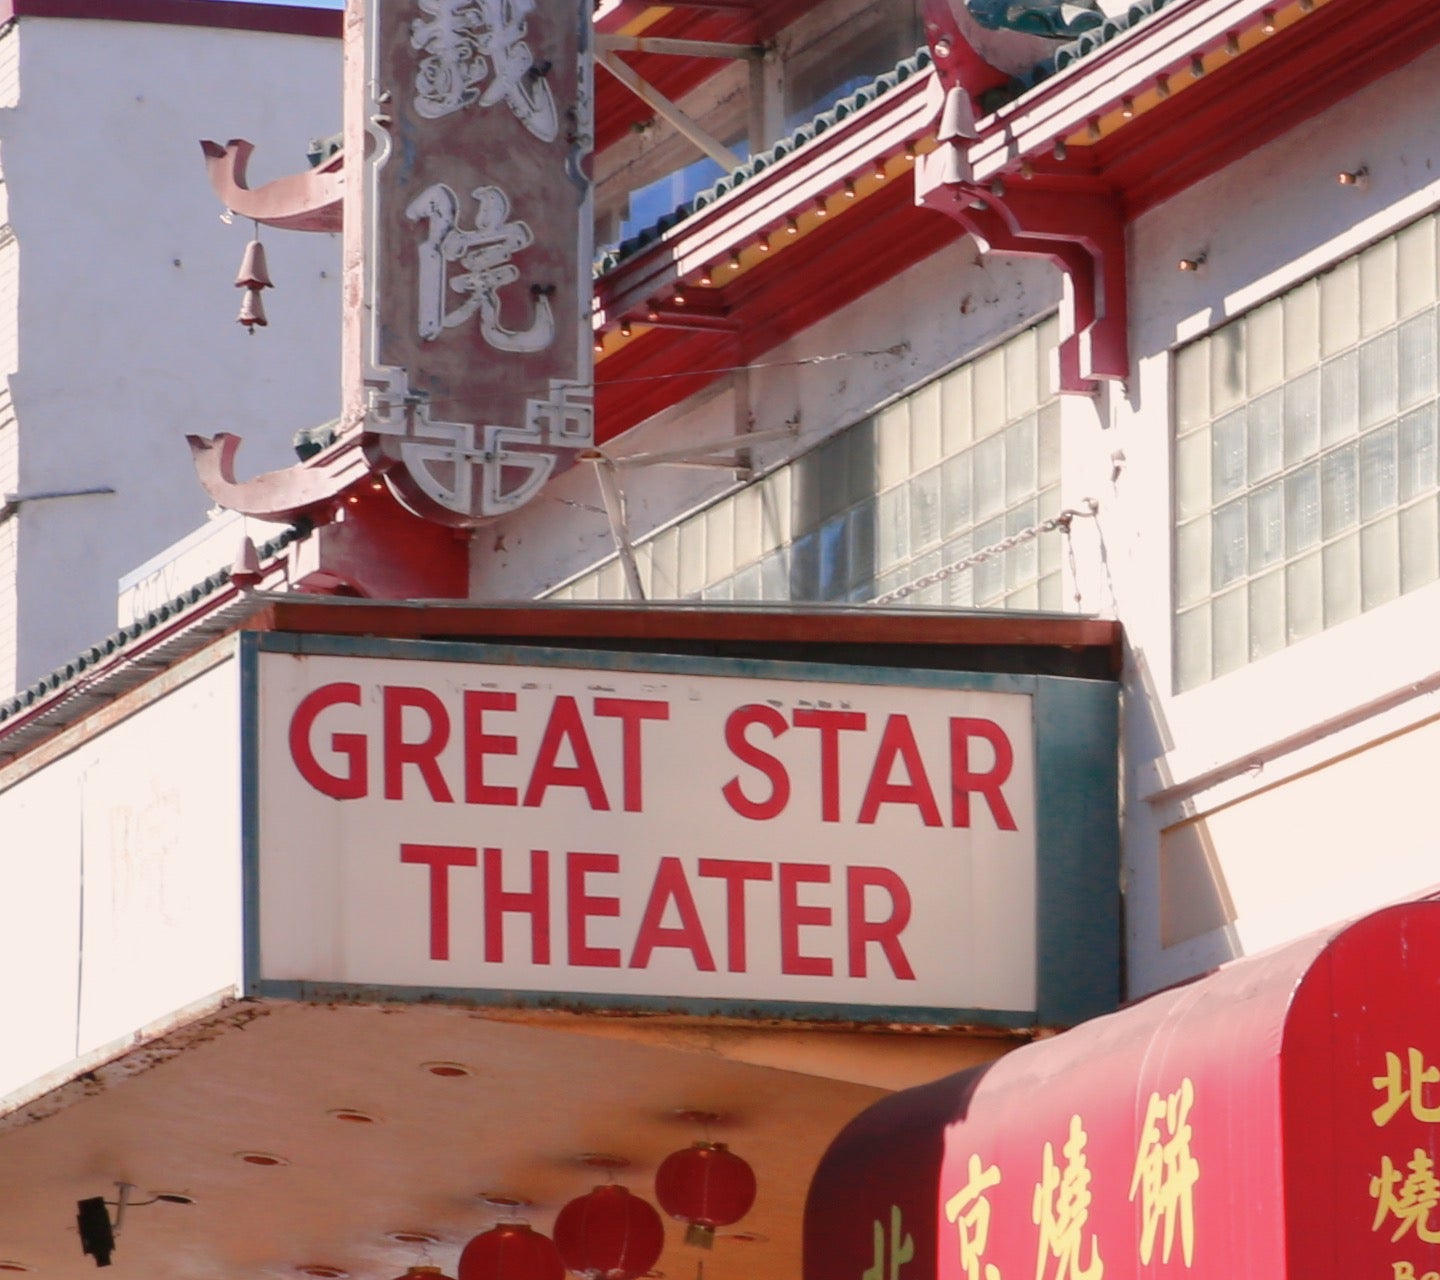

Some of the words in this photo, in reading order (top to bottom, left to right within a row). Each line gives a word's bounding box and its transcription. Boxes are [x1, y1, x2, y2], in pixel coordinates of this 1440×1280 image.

[289, 681, 671, 815] GREAT
[721, 702, 1019, 832] STAR
[400, 843, 917, 981] THEATER
